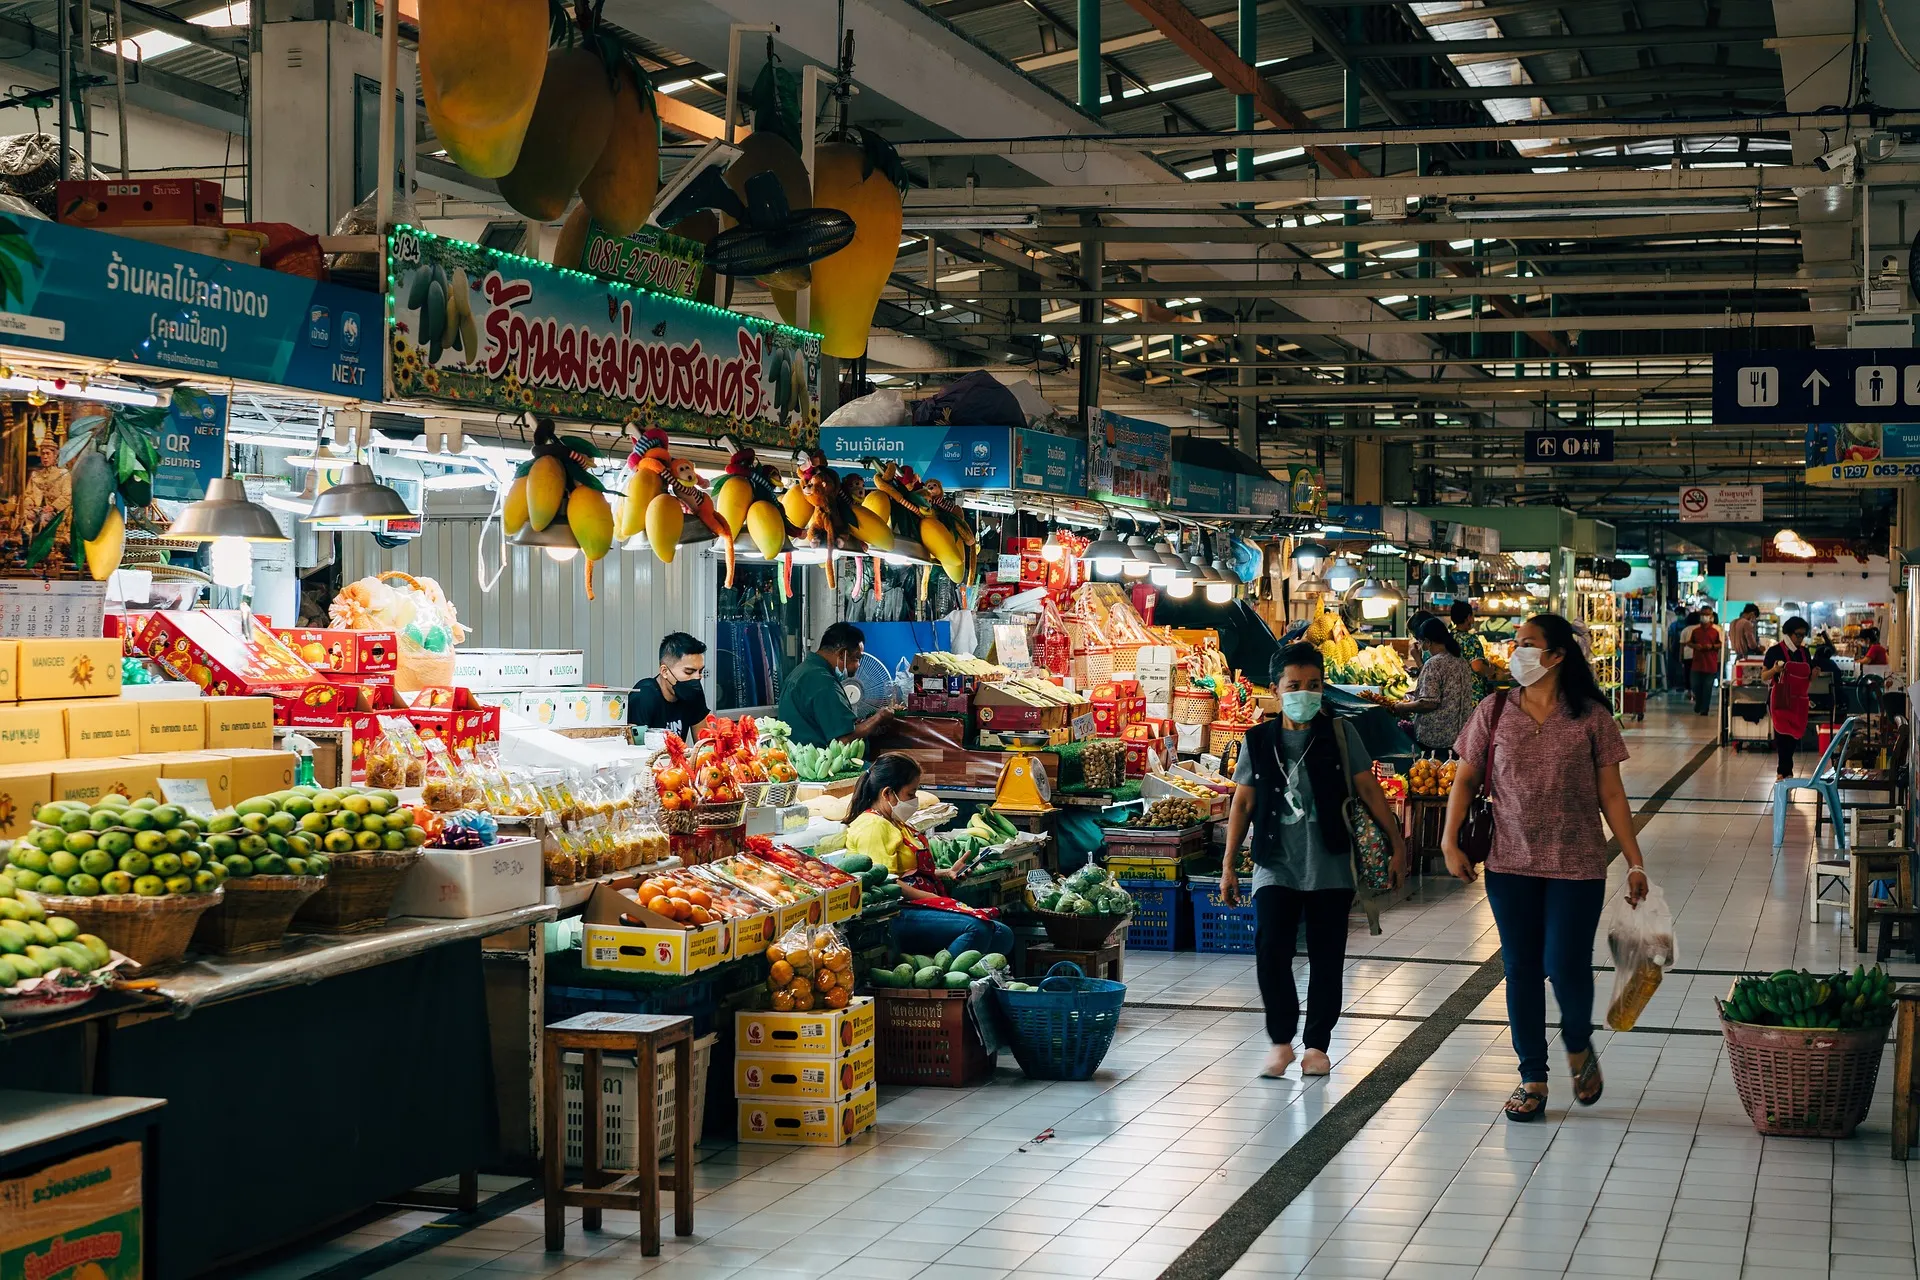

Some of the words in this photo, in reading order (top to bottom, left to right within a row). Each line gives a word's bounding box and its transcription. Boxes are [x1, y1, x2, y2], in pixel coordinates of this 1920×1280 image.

[393, 233, 420, 262] 6/34
[588, 236, 697, 296] 081-2790074
[151, 310, 228, 353] (คุณเปี๊ยก)
[484, 271, 763, 422] ร้านมะม่วงสมศรี
[332, 363, 366, 386] NEXT
[194, 426, 221, 437] NEXT
[166, 434, 191, 453] QR
[835, 436, 905, 451] ร้านเจ๊เผือก
[160, 457, 201, 469] ธนาคาร
[964, 466, 997, 477] NEXT
[1843, 465, 1868, 478] 1297
[12, 614, 20, 622] 10
[32, 656, 65, 668] MANGOES
[504, 665, 526, 676] MANGO
[554, 665, 574, 675] MANGO
[1079, 721, 1093, 736] 100
[64, 786, 100, 800] MANGOES
